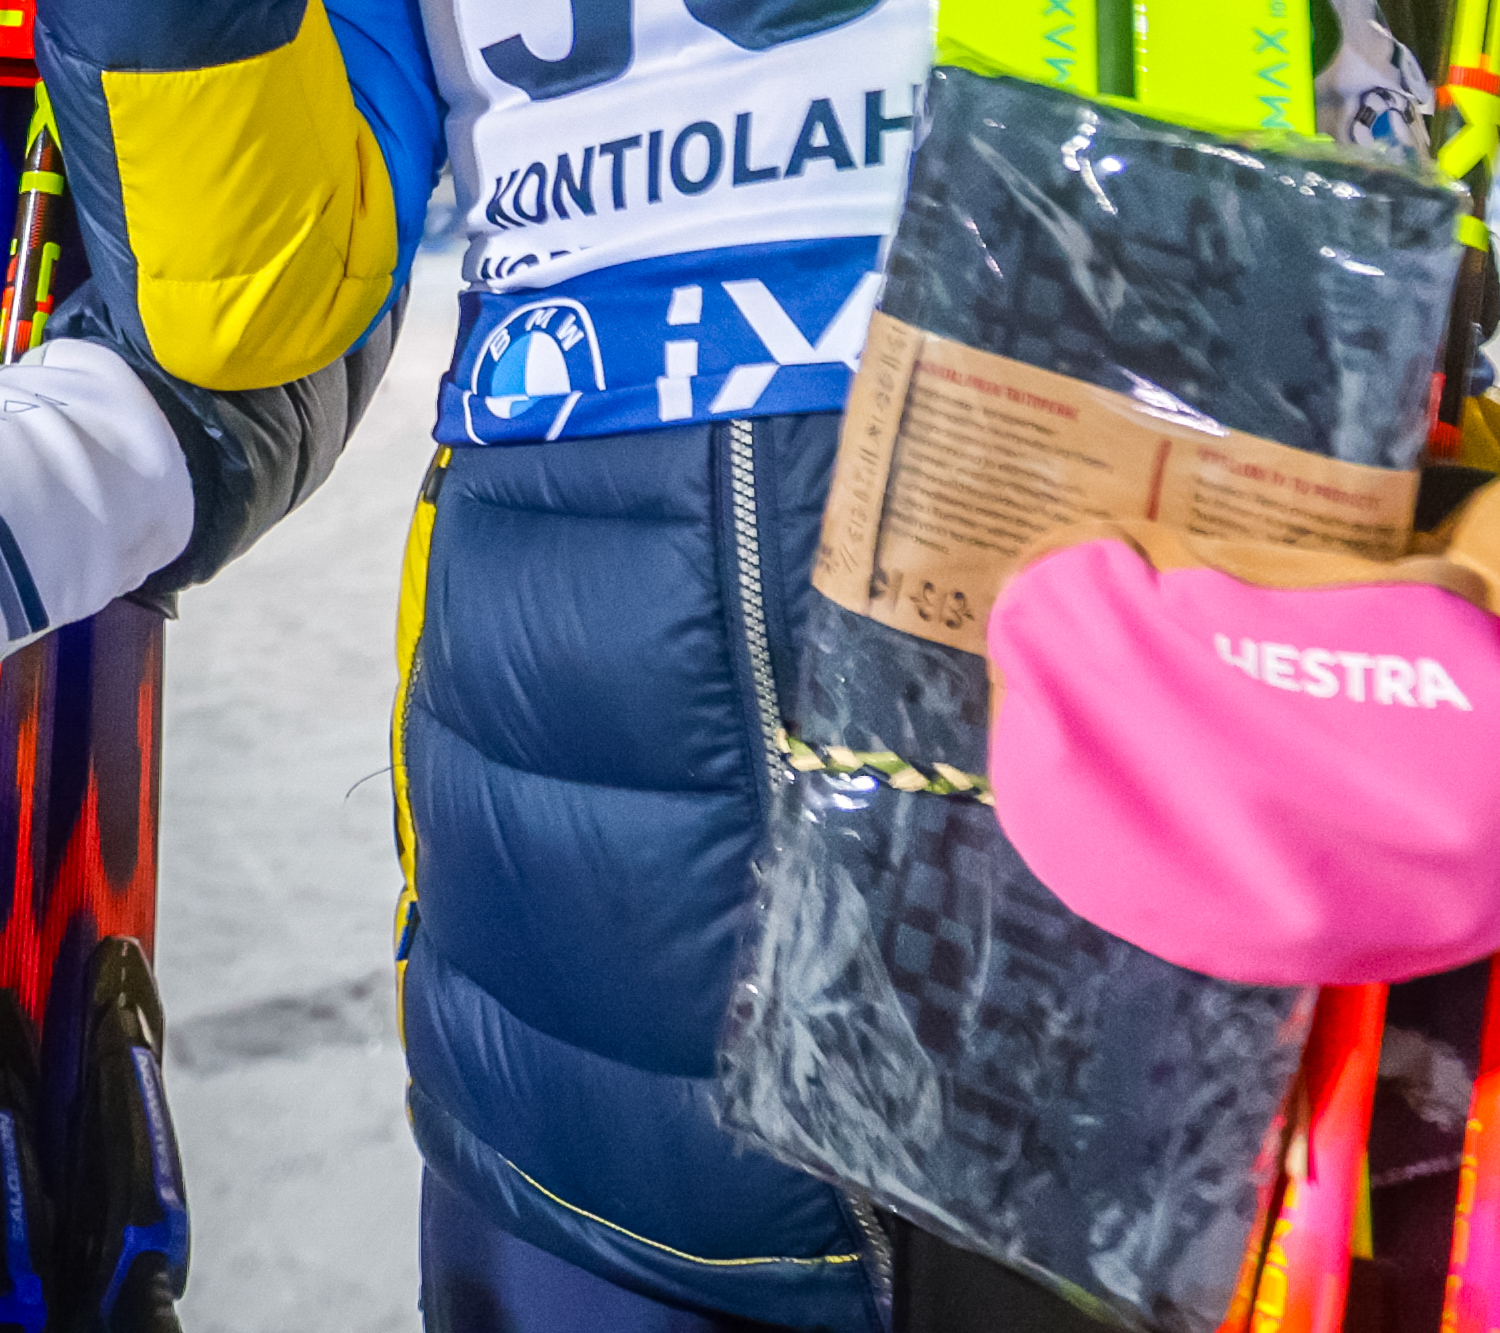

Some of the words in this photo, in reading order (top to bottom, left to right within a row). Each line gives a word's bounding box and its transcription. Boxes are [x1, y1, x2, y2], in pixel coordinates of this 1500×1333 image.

[1253, 27, 1295, 130] MAX
[485, 84, 923, 230] KONTIOLAH
[489, 306, 586, 363] BMW
